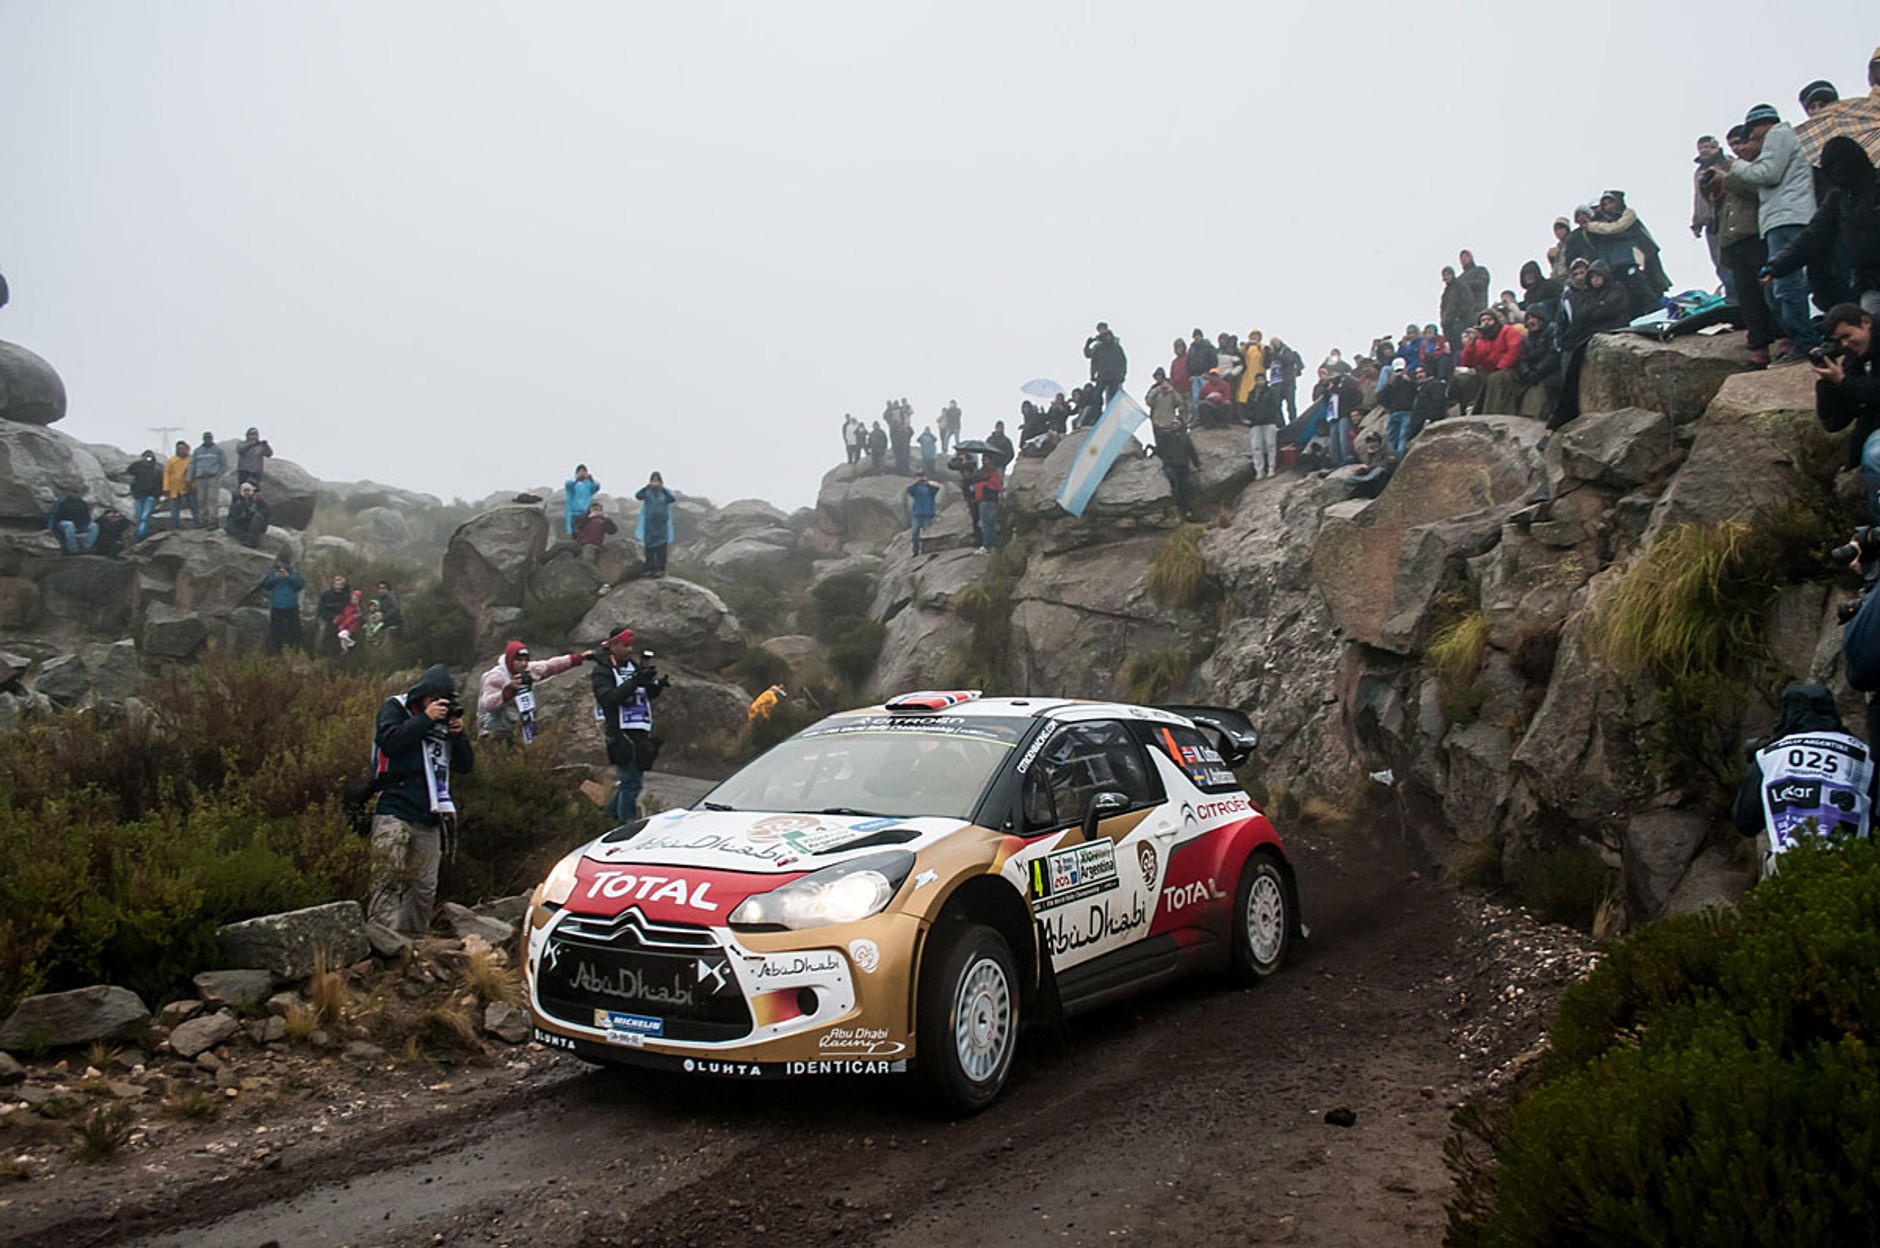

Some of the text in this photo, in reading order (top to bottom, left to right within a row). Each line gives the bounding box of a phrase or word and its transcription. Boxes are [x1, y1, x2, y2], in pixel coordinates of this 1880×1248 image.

[1788, 749, 1838, 774] 025
[1771, 785, 1814, 802] Lexar
[1081, 859, 1114, 880] Argentina
[587, 870, 719, 911] TOTAL
[1163, 879, 1228, 913] TOTAL
[613, 1016, 661, 1030] MICHELIN
[830, 1027, 890, 1039] Abu Dhabi
[819, 1035, 885, 1054] Racing
[697, 1061, 762, 1077] LUHTA
[786, 1060, 890, 1075] IDENTICAR
